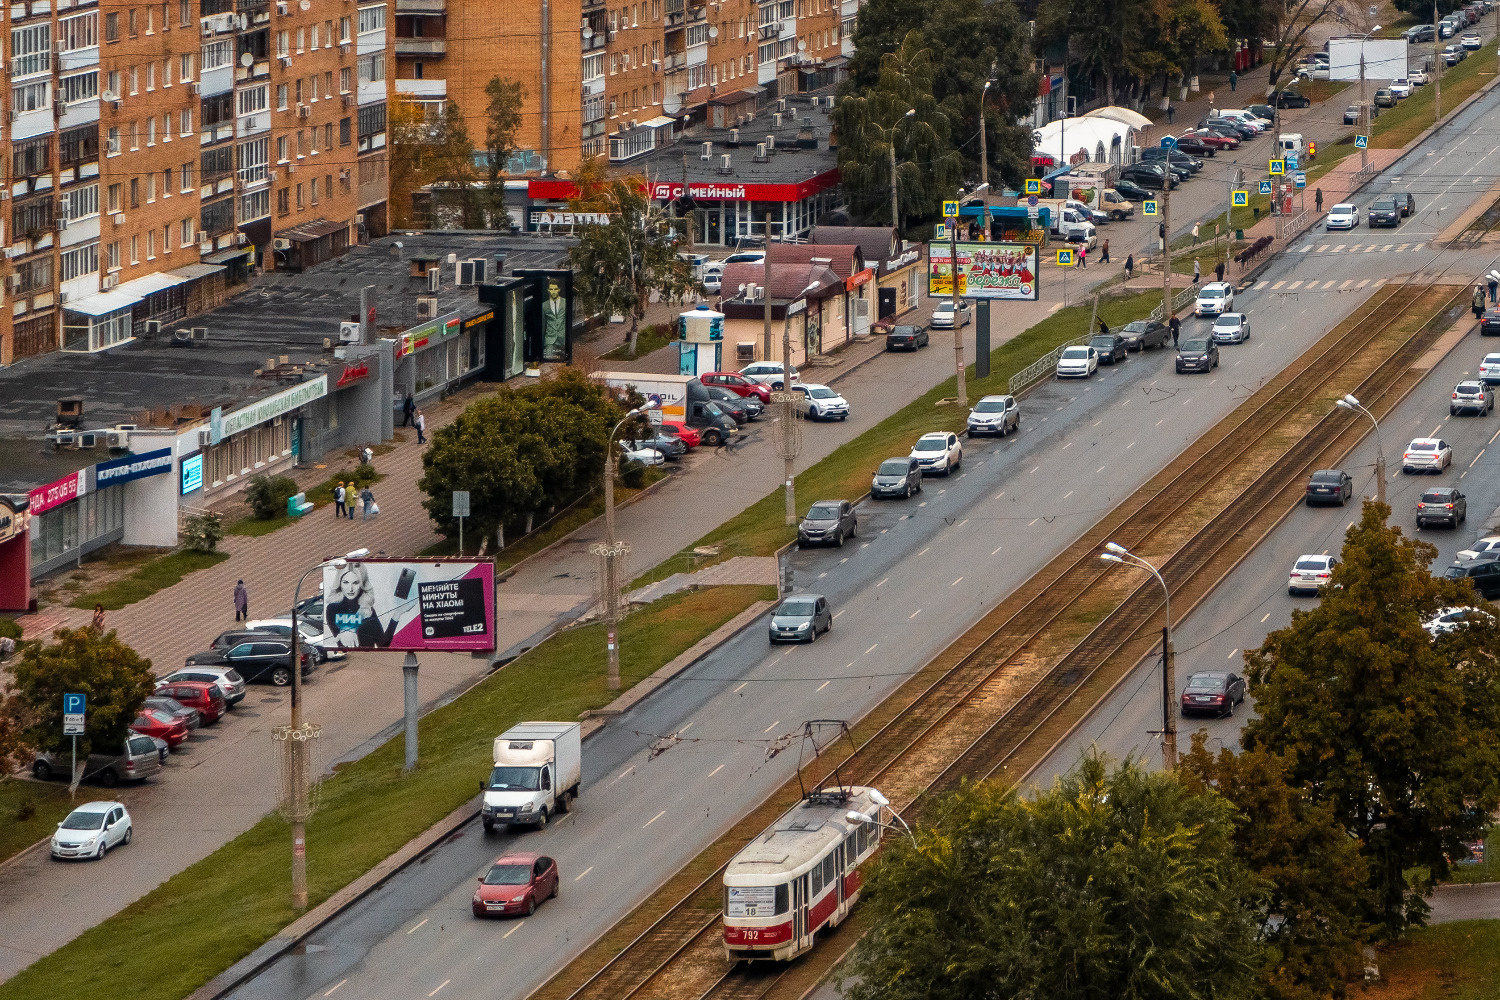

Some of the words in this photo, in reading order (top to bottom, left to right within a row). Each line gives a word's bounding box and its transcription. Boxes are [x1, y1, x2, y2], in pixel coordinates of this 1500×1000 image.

[967, 270, 1021, 289] берёзка
[421, 583, 459, 593] МЕНЯЙТЕ
[422, 592, 458, 601] МИНУТЫ
[435, 600, 464, 609] XIAOMI
[335, 613, 362, 625] МИН
[463, 623, 484, 633] TELE2
[69, 696, 80, 712] P
[745, 907, 756, 916] 18
[743, 930, 759, 940] 792
